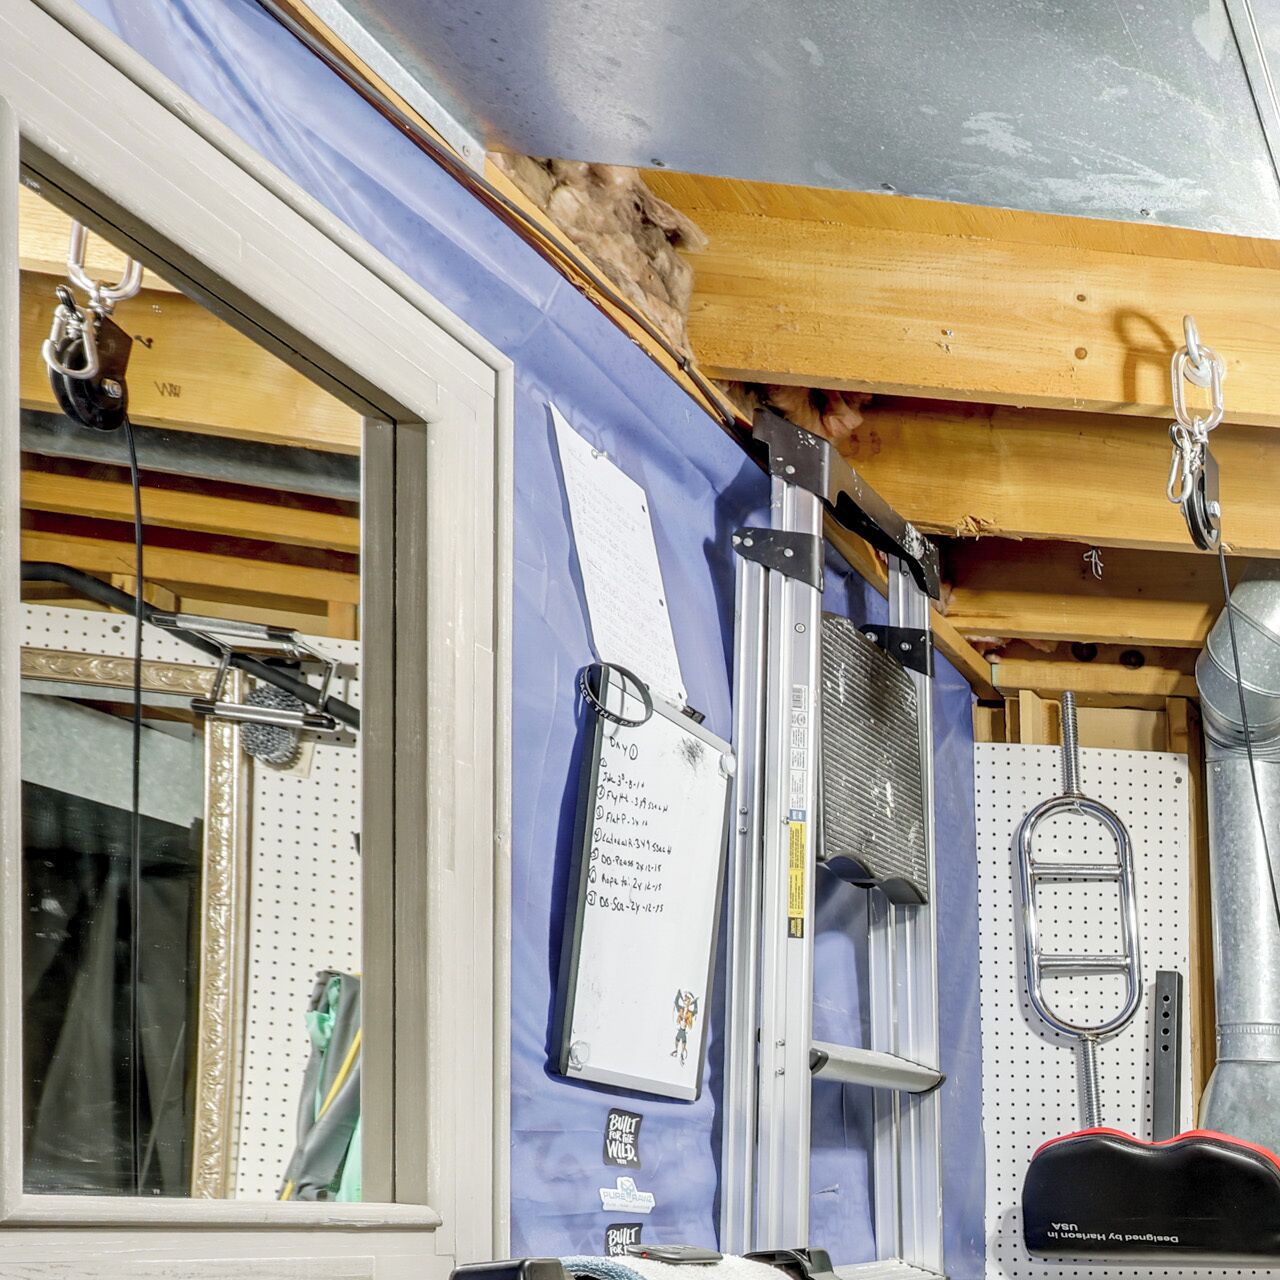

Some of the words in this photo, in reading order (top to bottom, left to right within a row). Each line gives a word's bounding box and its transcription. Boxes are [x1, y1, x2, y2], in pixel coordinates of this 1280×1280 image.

[594, 704, 617, 722] THE
[608, 1113, 640, 1133] BUILT
[608, 1130, 622, 1142] FOR
[606, 1139, 638, 1162] WILD.
[602, 1190, 626, 1200] PURE
[1051, 1222, 1079, 1231] USA
[607, 1226, 639, 1246] BUILT
[1047, 1231, 1059, 1240] in
[1060, 1231, 1106, 1241] Harison
[1108, 1232, 1123, 1242] by
[1124, 1233, 1179, 1244] Designed
[608, 1244, 624, 1256] FOR
